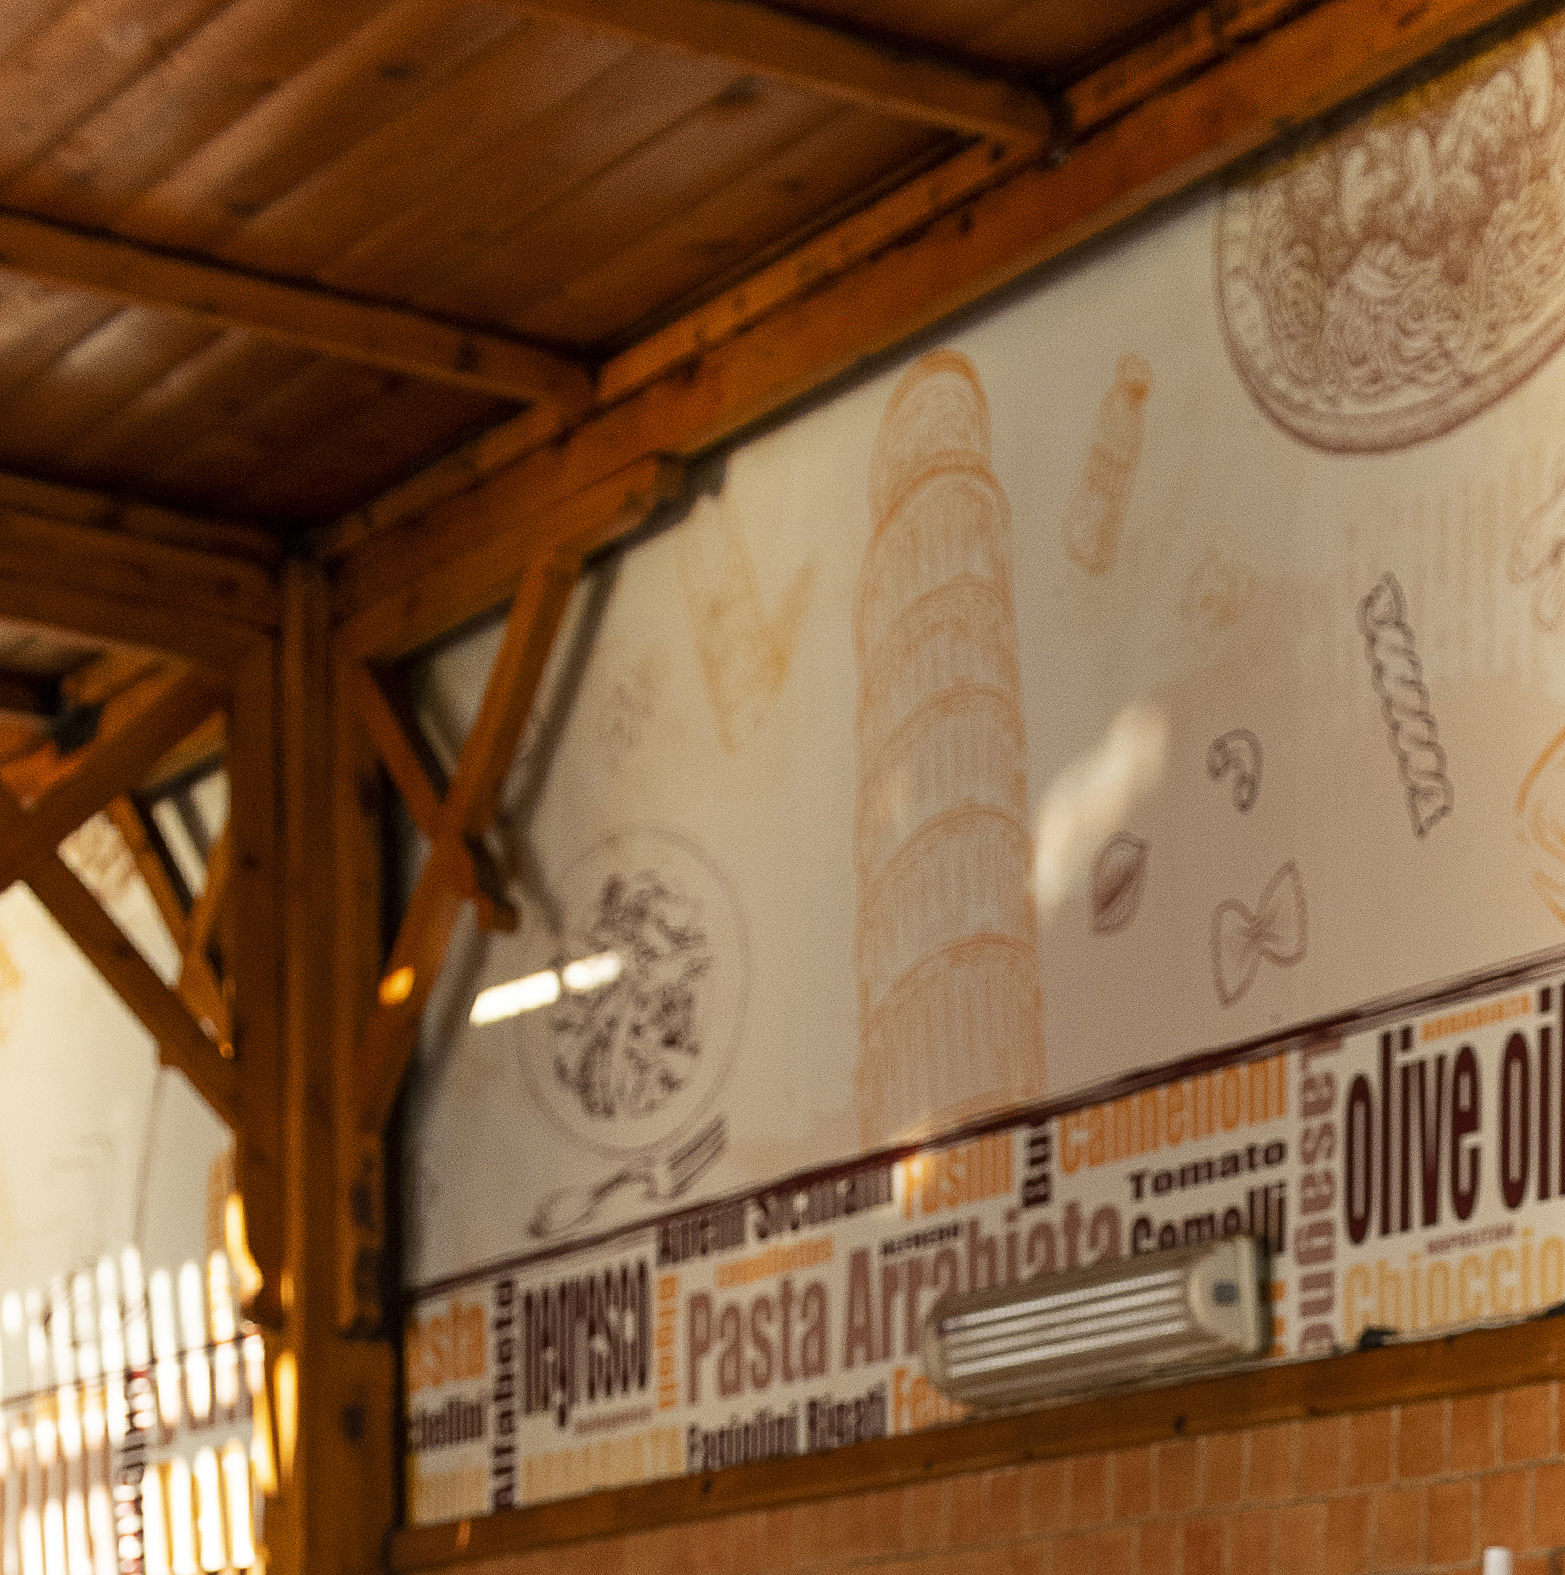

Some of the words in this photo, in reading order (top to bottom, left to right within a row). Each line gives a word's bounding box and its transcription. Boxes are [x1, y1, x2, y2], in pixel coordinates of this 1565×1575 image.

[1129, 1141, 1287, 1199] Tomato
[1344, 1024, 1482, 1246] olive
[687, 1276, 830, 1407] Pasta
